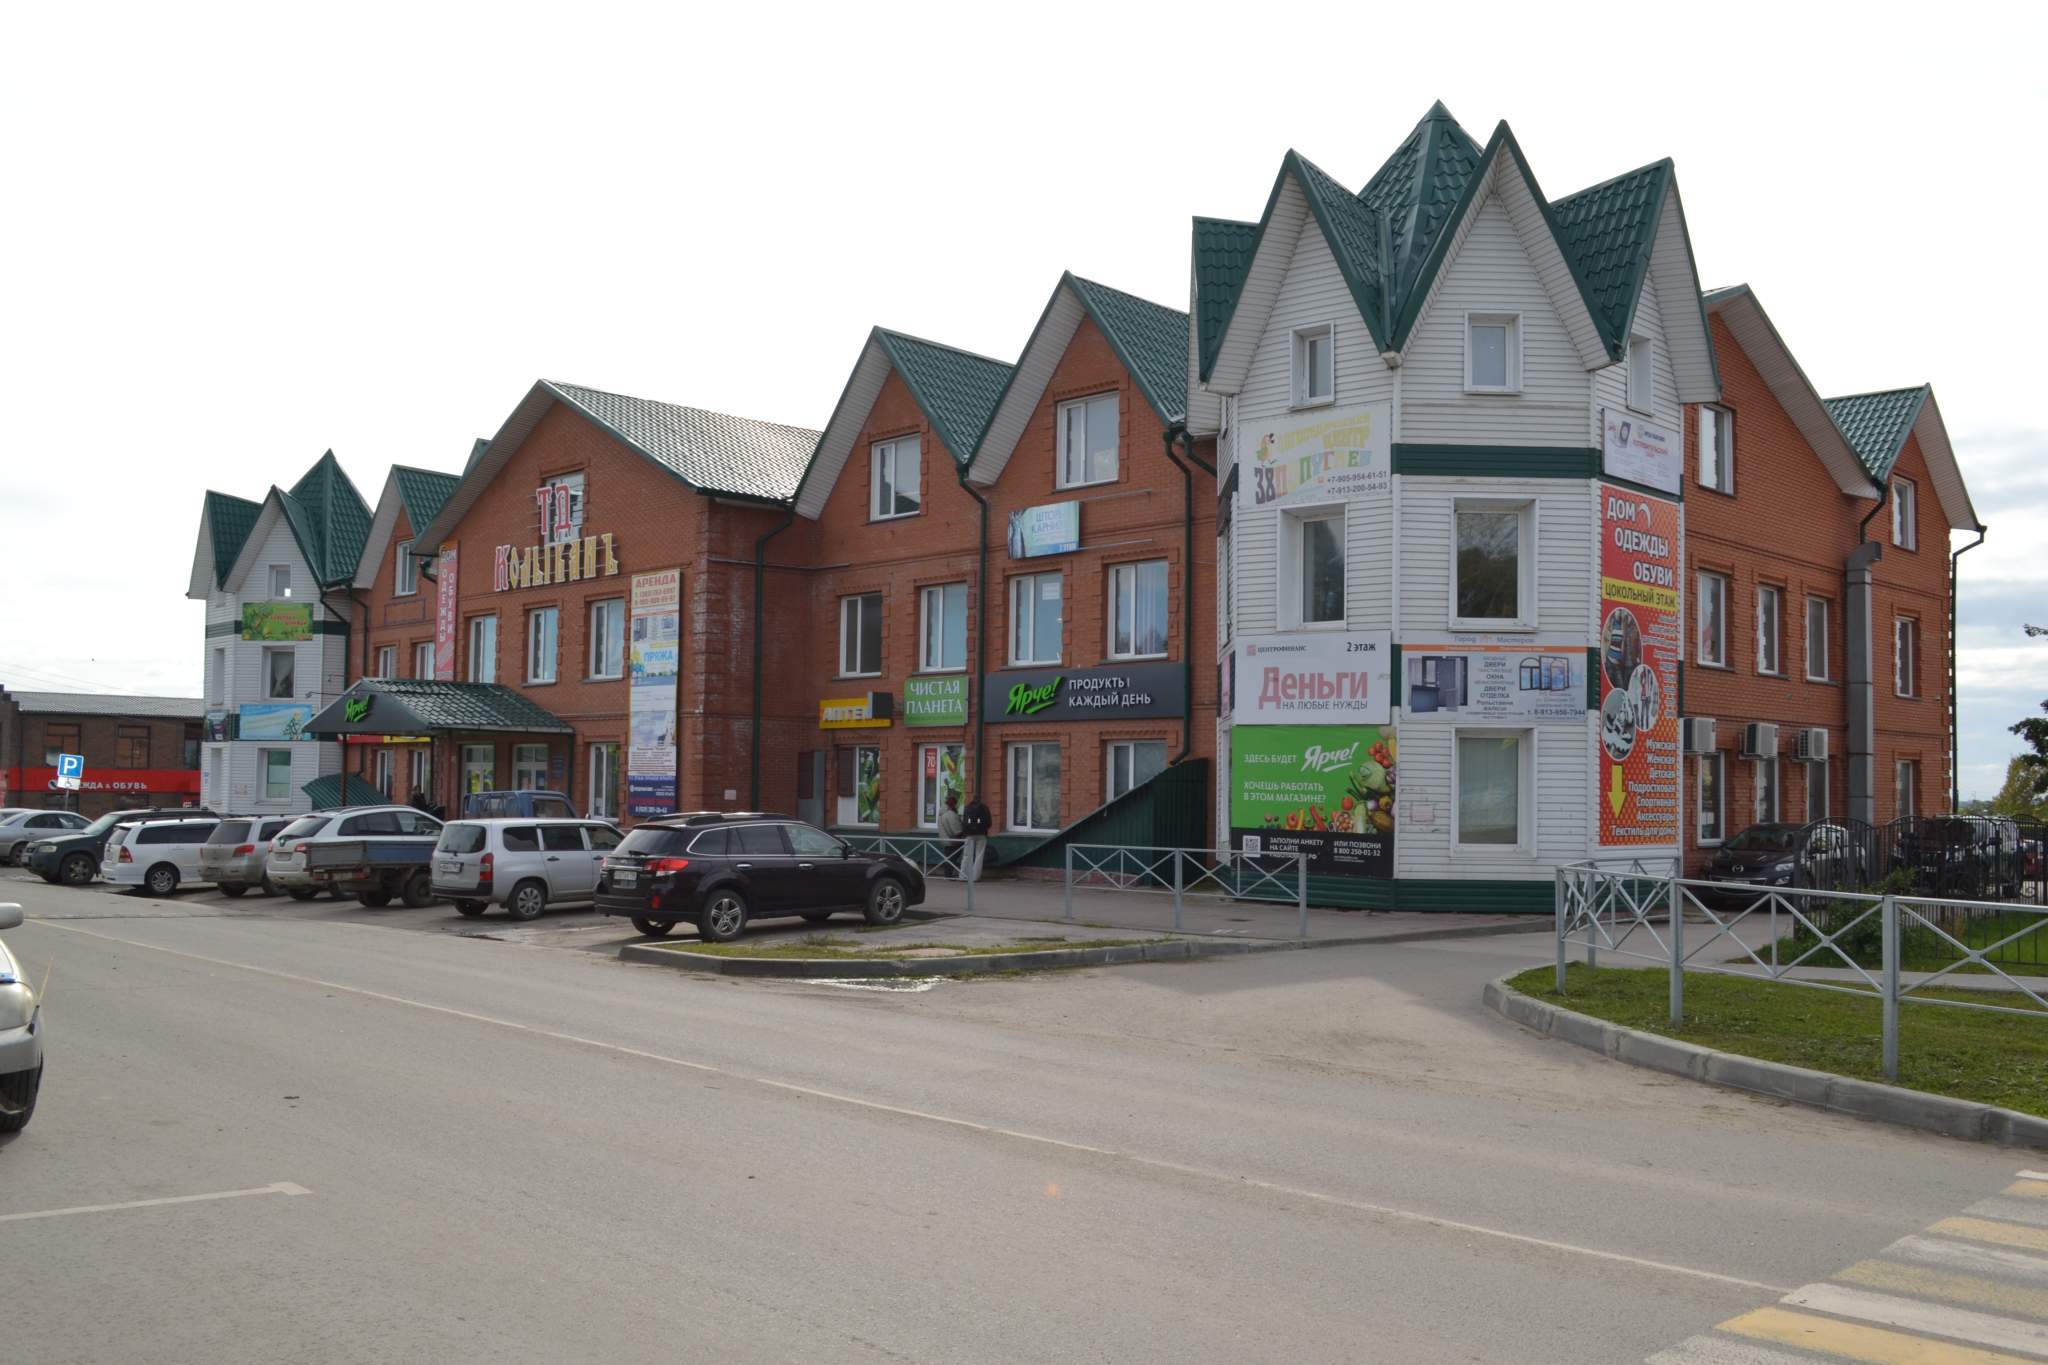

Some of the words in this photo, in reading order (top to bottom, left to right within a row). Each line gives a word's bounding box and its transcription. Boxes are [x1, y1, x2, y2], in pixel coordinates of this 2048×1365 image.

[536, 483, 571, 541] ТД
[1607, 496, 1636, 521] ДОМ
[1615, 527, 1669, 558] ОДЕЖДЫ
[636, 574, 676, 588] АРЕНДА
[1633, 561, 1673, 587] ОБУВИ
[1605, 582, 1654, 603] ЦОКОЛЬНЫЙ
[1655, 592, 1676, 608] ЭТАЖ
[1346, 642, 1352, 652] 2
[1353, 642, 1376, 652] этаж
[910, 680, 960, 696] ЧИСТАЯ
[1005, 676, 1065, 715] Ярче!
[1258, 666, 1368, 710] Деньги
[906, 698, 963, 715] ПЛАНЕТА
[1068, 691, 1119, 708] КАЖДЫЙ
[1121, 693, 1152, 708] ДЕНЬ
[1282, 701, 1295, 710] НА
[1298, 701, 1329, 710] ЛЮБЫЕ
[1333, 701, 1368, 710] НУЖДЫ
[1244, 754, 1270, 764] ЗДЕСЬ
[1271, 754, 1297, 764] БУДЕТ
[1301, 742, 1360, 772] Ярче!
[112, 782, 147, 790] ОБУВЬ
[1243, 781, 1280, 790] ХОЧЕШЬ
[1281, 782, 1324, 791] РАБОТАТЬ
[1243, 792, 1249, 801] В
[1250, 793, 1274, 801] ЭТОМ
[1276, 793, 1326, 803] МАГАЗИНЕ?
[1270, 837, 1300, 845] ЗАПОЛНИ
[1300, 838, 1324, 846] АНКЕТУ
[1279, 844, 1299, 852] САЙТЕ
[1349, 841, 1381, 849] ПОЗВОНИ
